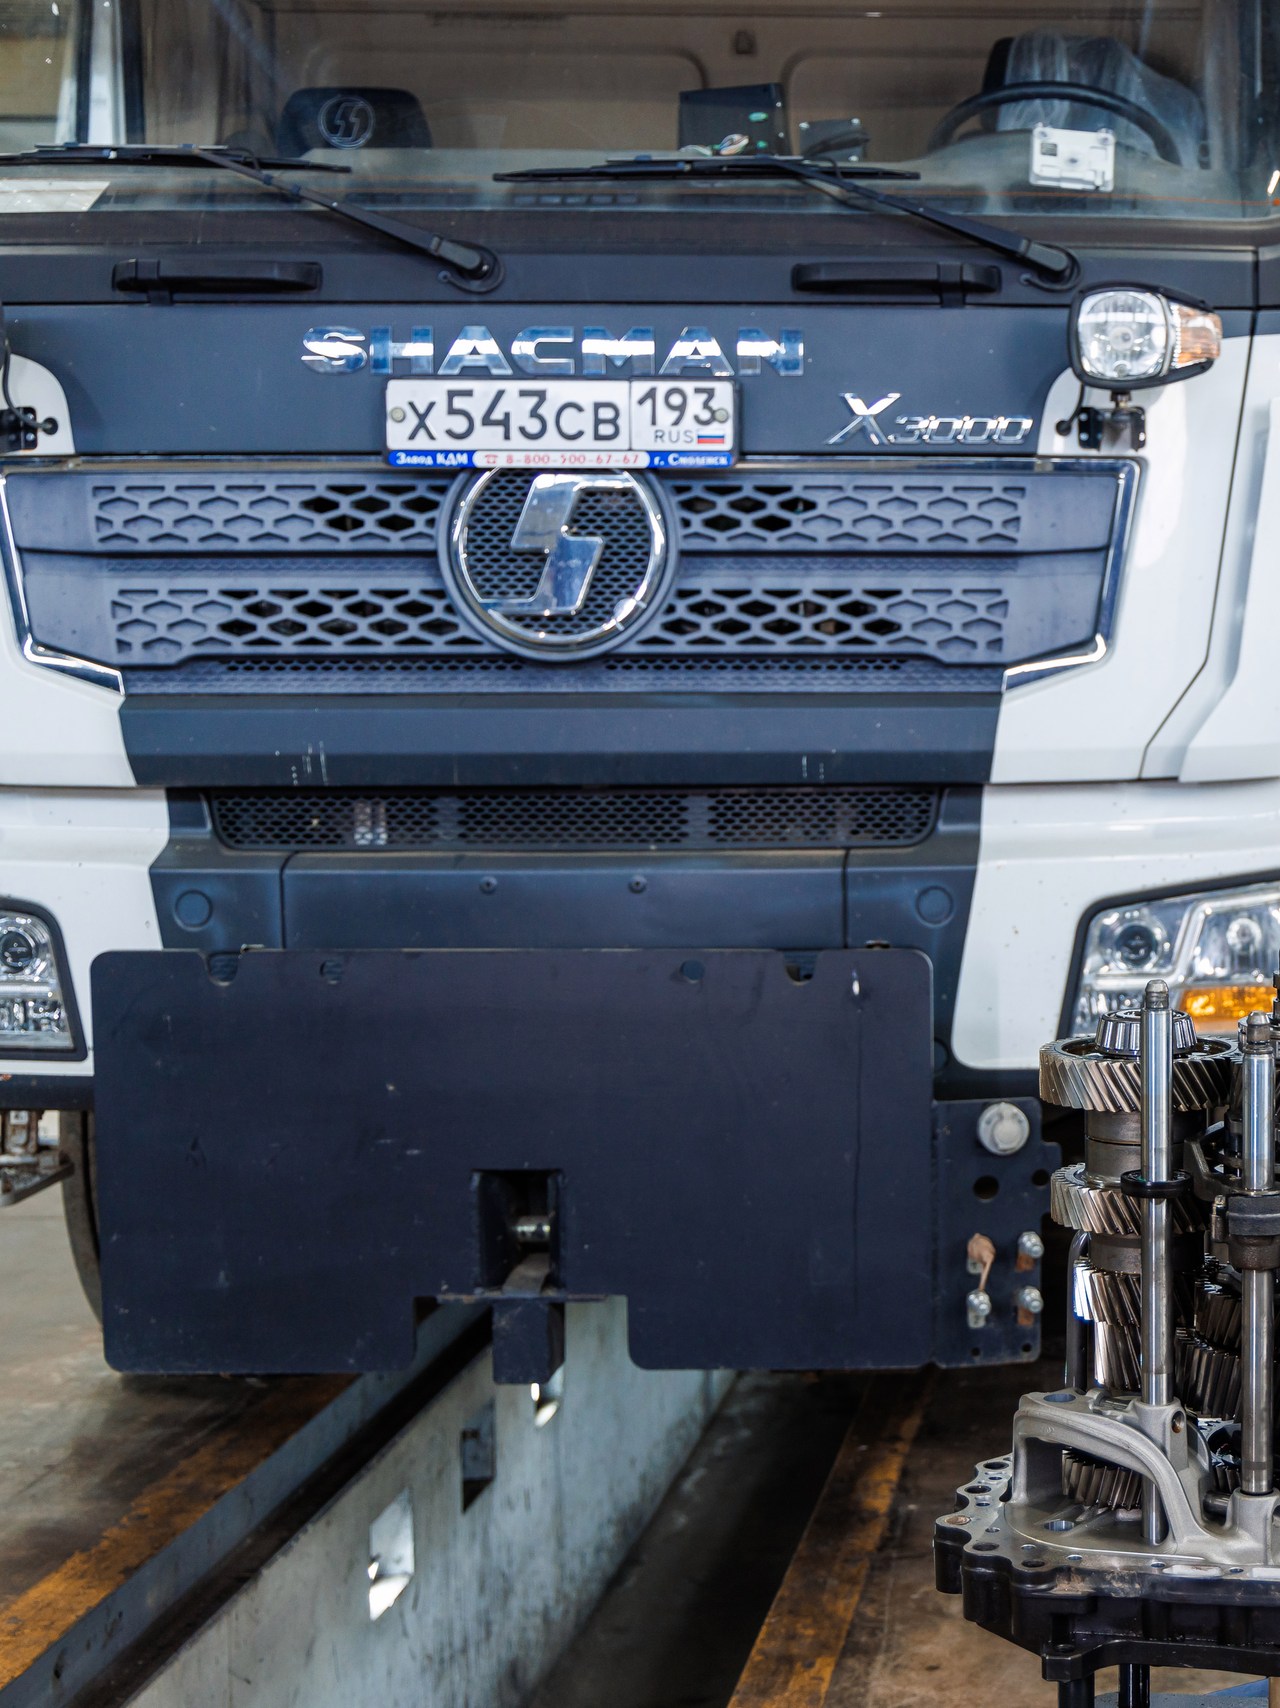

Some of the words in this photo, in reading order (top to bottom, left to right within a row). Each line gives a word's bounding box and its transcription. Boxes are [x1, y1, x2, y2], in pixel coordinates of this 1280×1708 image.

[301, 326, 804, 376] SHACMAN
[637, 387, 716, 426] 193
[824, 392, 1033, 445] X3000
[653, 429, 694, 443] RUS
[436, 452, 468, 466] КДМ
